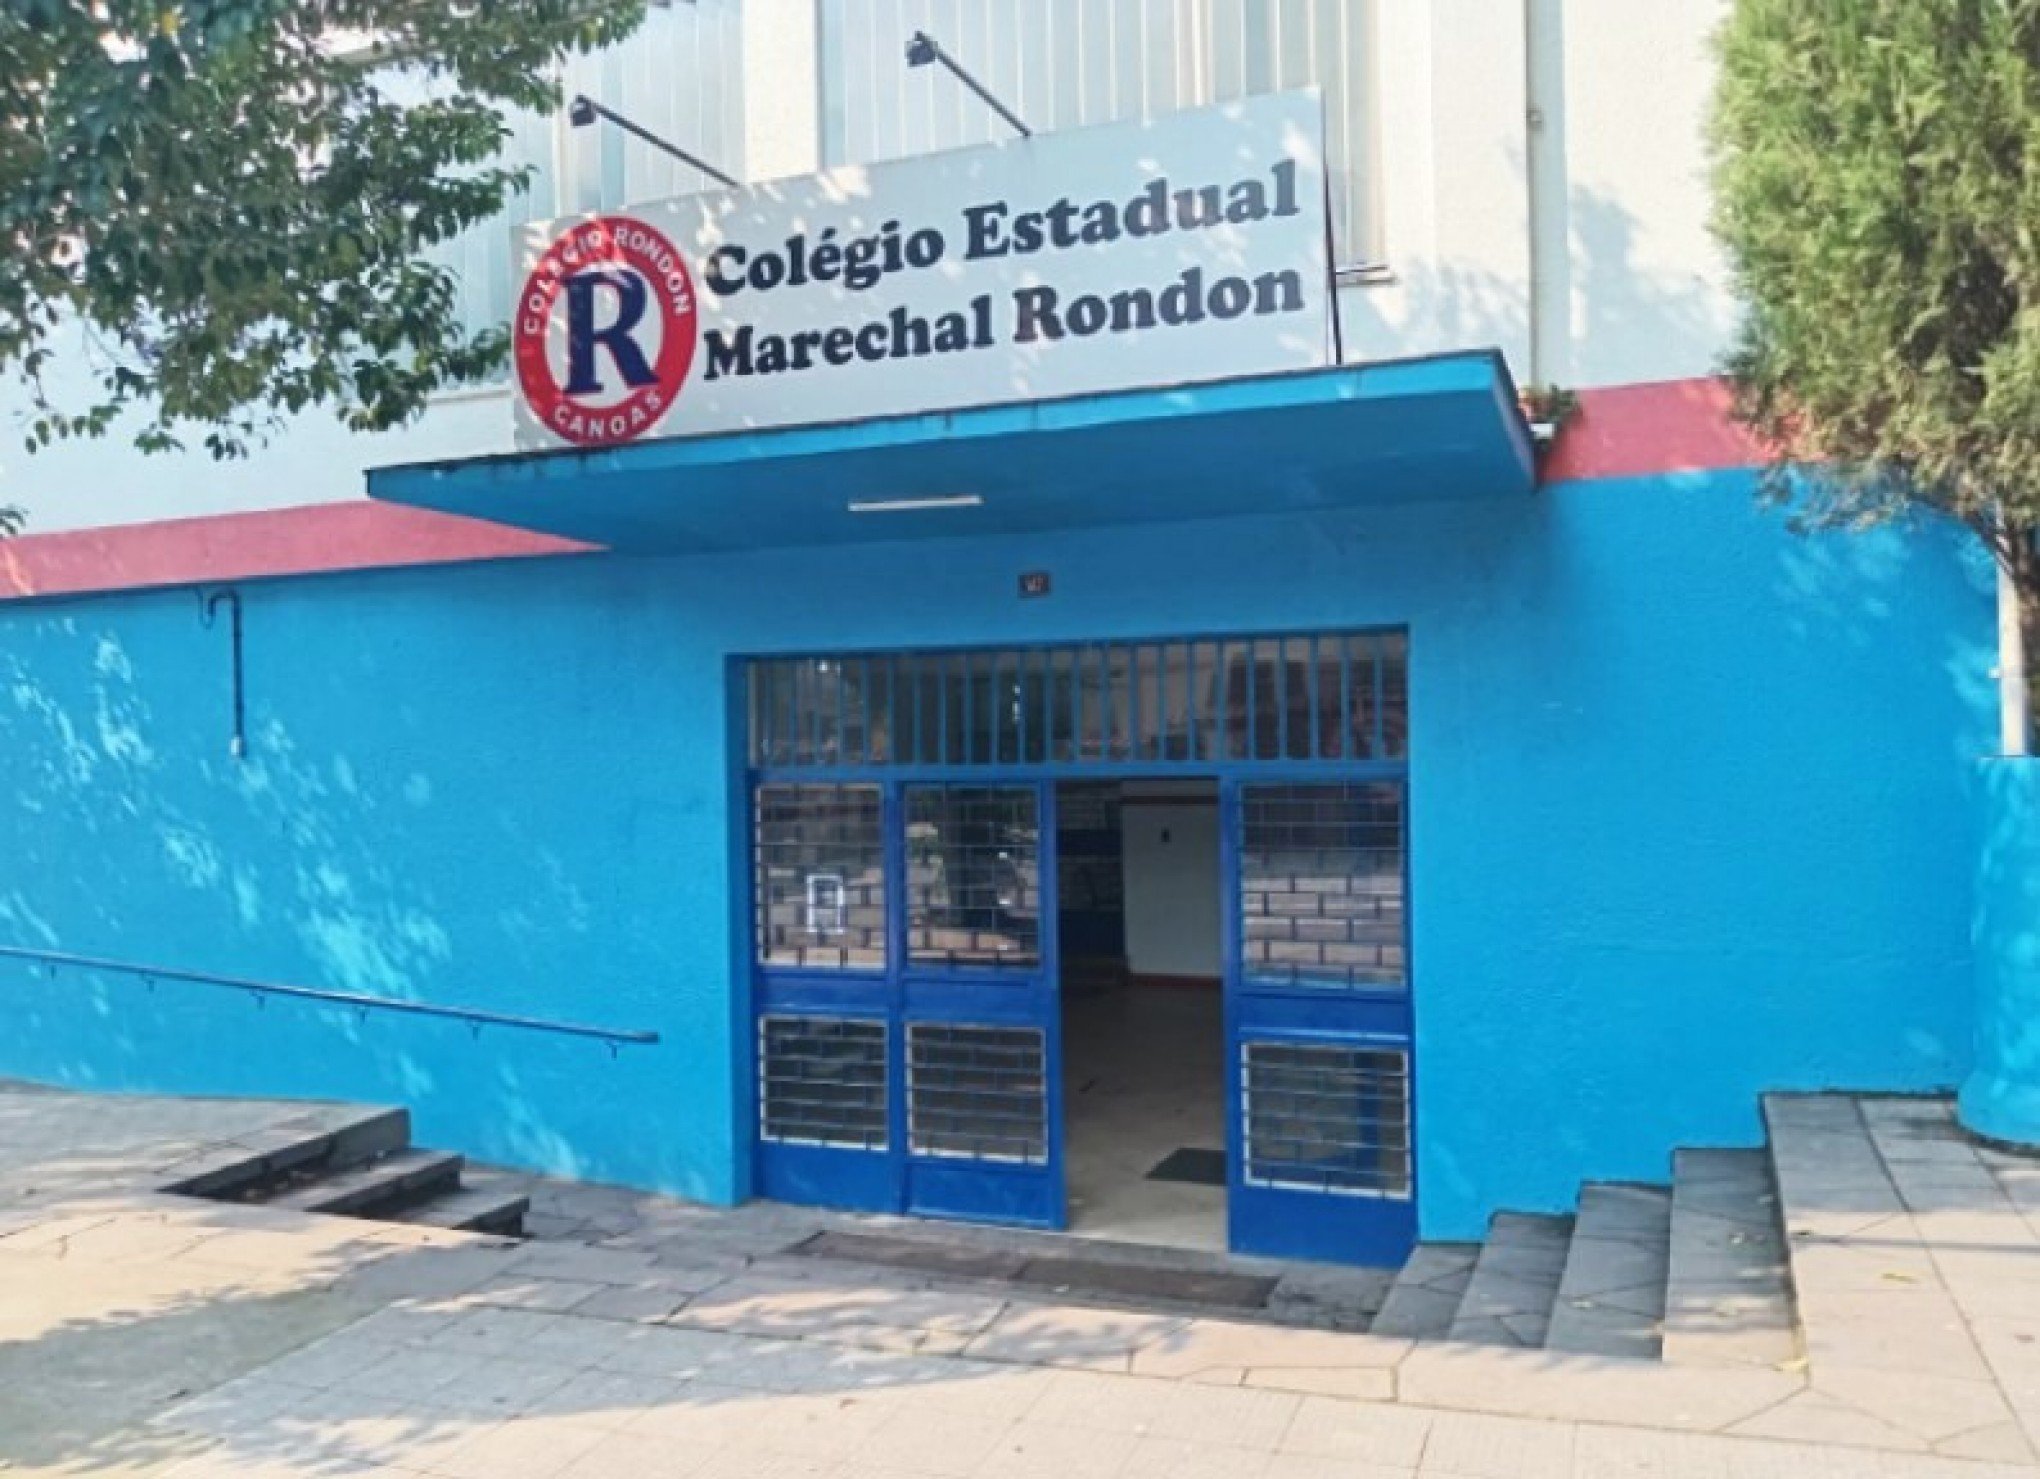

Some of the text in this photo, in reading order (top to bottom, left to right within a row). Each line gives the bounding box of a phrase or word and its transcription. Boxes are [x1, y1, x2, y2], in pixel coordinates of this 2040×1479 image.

[614, 226, 691, 316] RONDON
[705, 158, 1299, 296] Colégio Estadual
[562, 268, 661, 394] R
[703, 266, 1305, 381] Marechal Rondon
[554, 392, 662, 438] CANOAS
